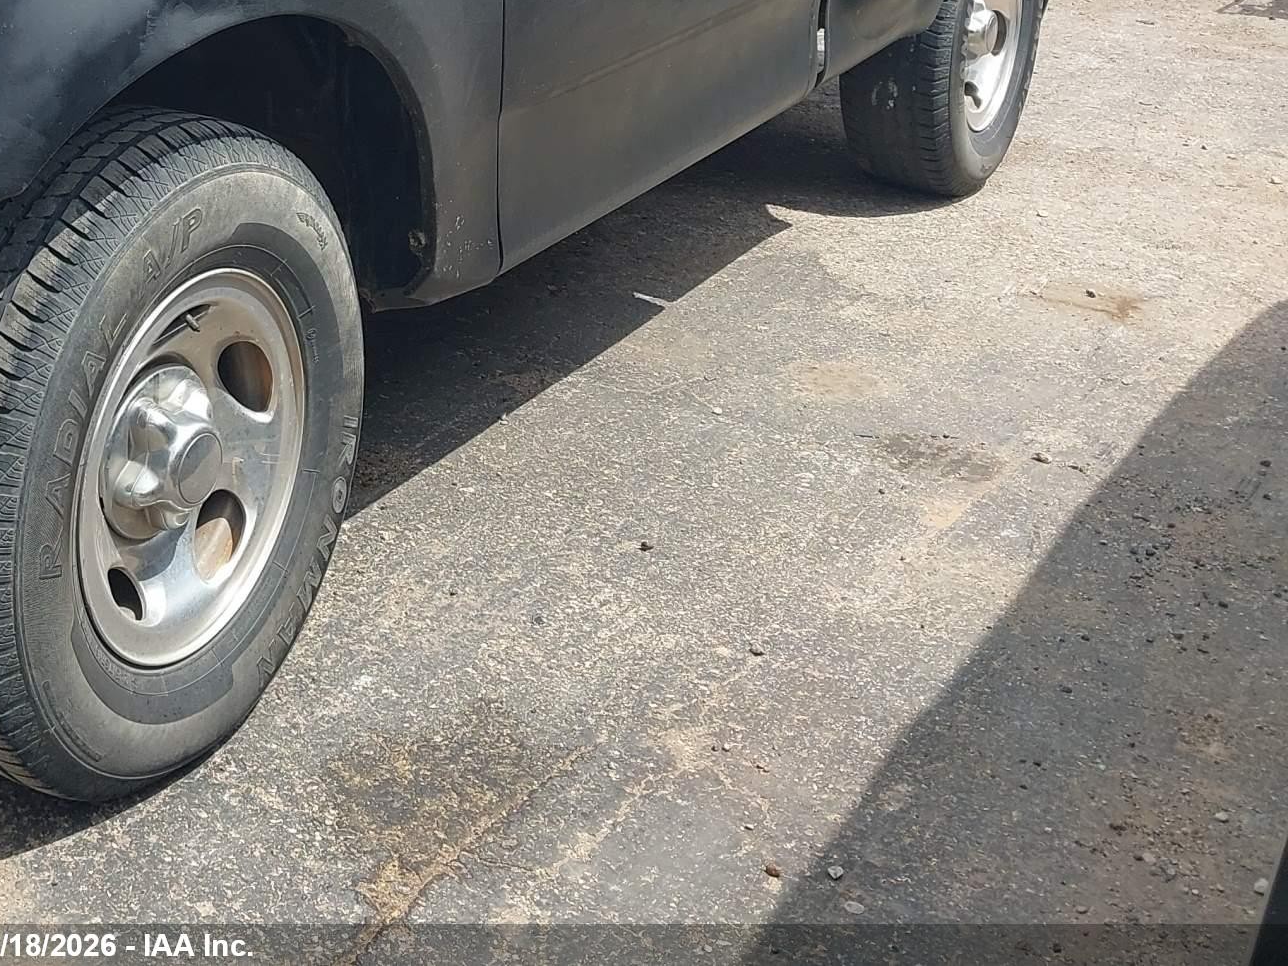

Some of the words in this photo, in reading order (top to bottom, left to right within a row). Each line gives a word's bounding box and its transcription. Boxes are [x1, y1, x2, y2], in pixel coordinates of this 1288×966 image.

[38, 312, 129, 581] RADIAL
[141, 206, 204, 284] A/P
[255, 414, 360, 684] IRONMAN
